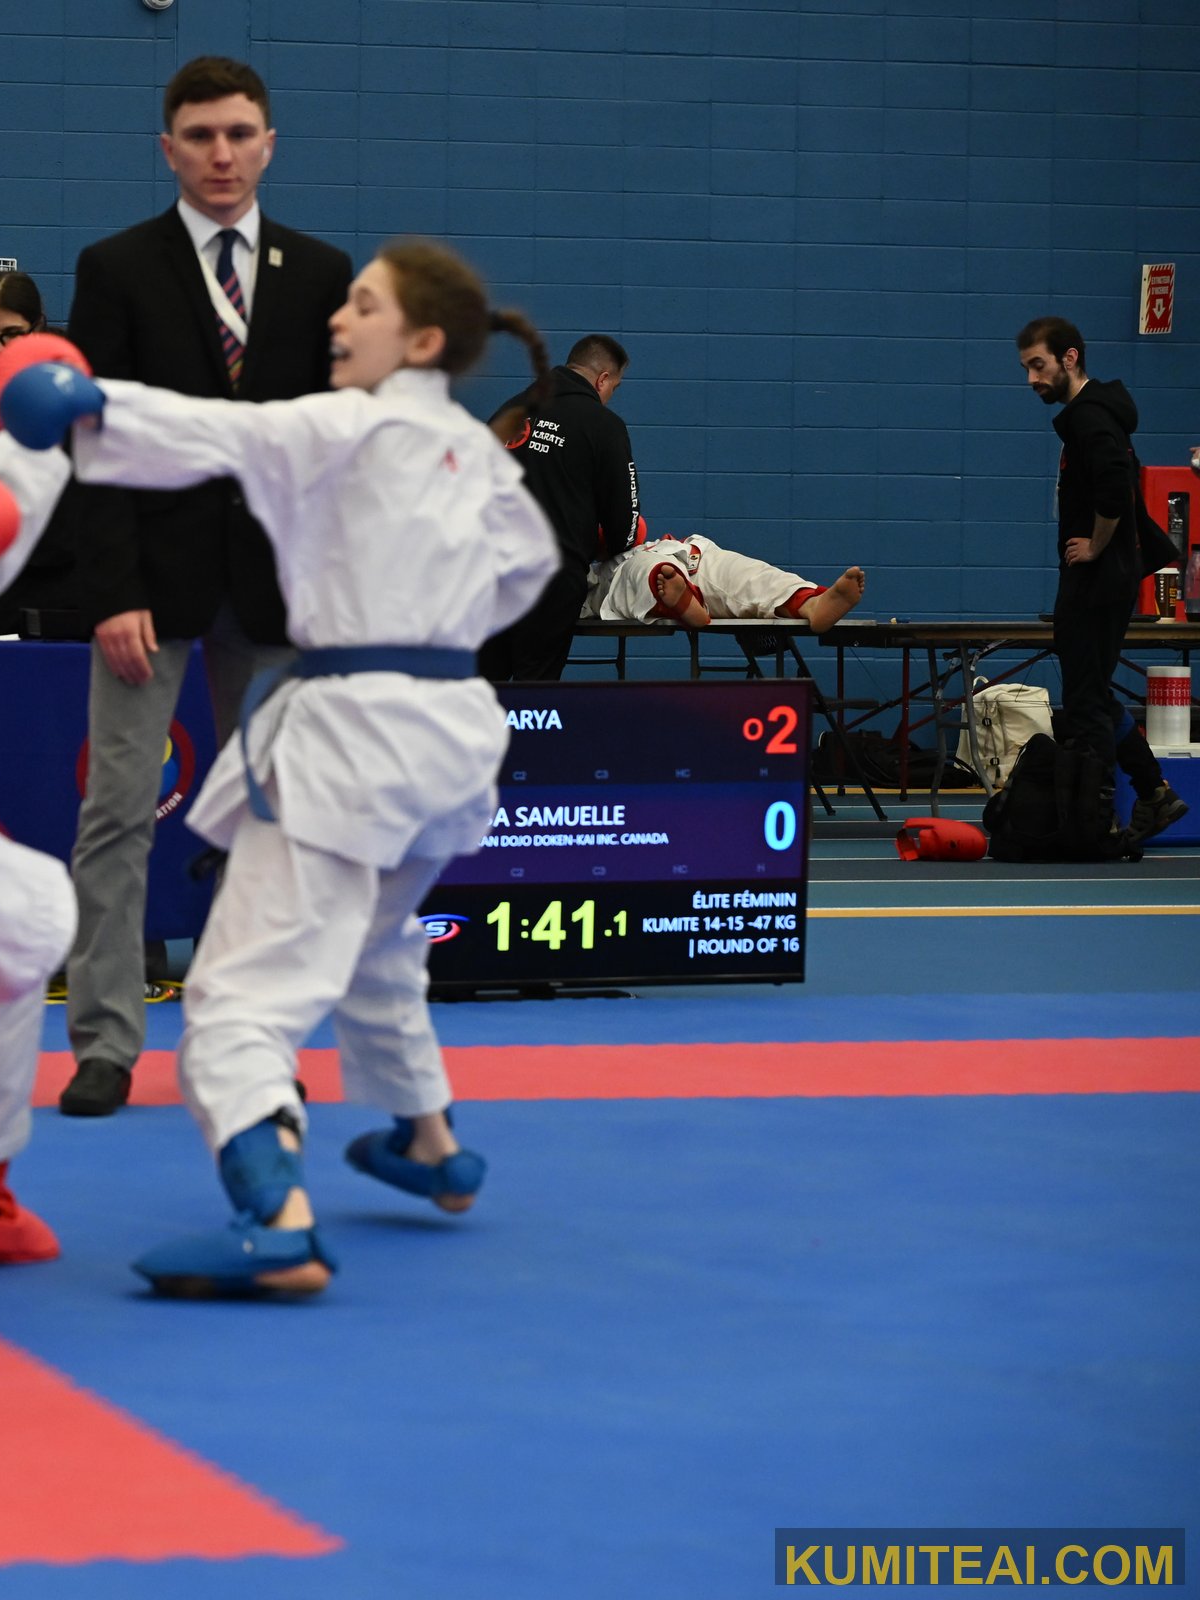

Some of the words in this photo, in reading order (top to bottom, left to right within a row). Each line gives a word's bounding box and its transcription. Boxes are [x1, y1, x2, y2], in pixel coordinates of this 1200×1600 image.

[537, 420, 560, 431] APEX
[528, 441, 549, 453] DOJO
[628, 462, 639, 508] UNDER
[504, 709, 563, 730] ARYA
[488, 807, 510, 828] A
[515, 805, 626, 828] SAMUELLE
[764, 801, 797, 851] 0
[500, 834, 532, 848] DOJO
[620, 832, 669, 845] CANADA
[692, 890, 730, 909] ÉLITE
[733, 889, 797, 908] FÉMININ
[642, 916, 700, 932] KUMITE
[703, 915, 744, 931] 14-15
[747, 914, 772, 930] -47
[774, 914, 797, 930] KG
[697, 938, 755, 954] ROUND
[756, 937, 778, 953] OF
[782, 937, 800, 953] 16
